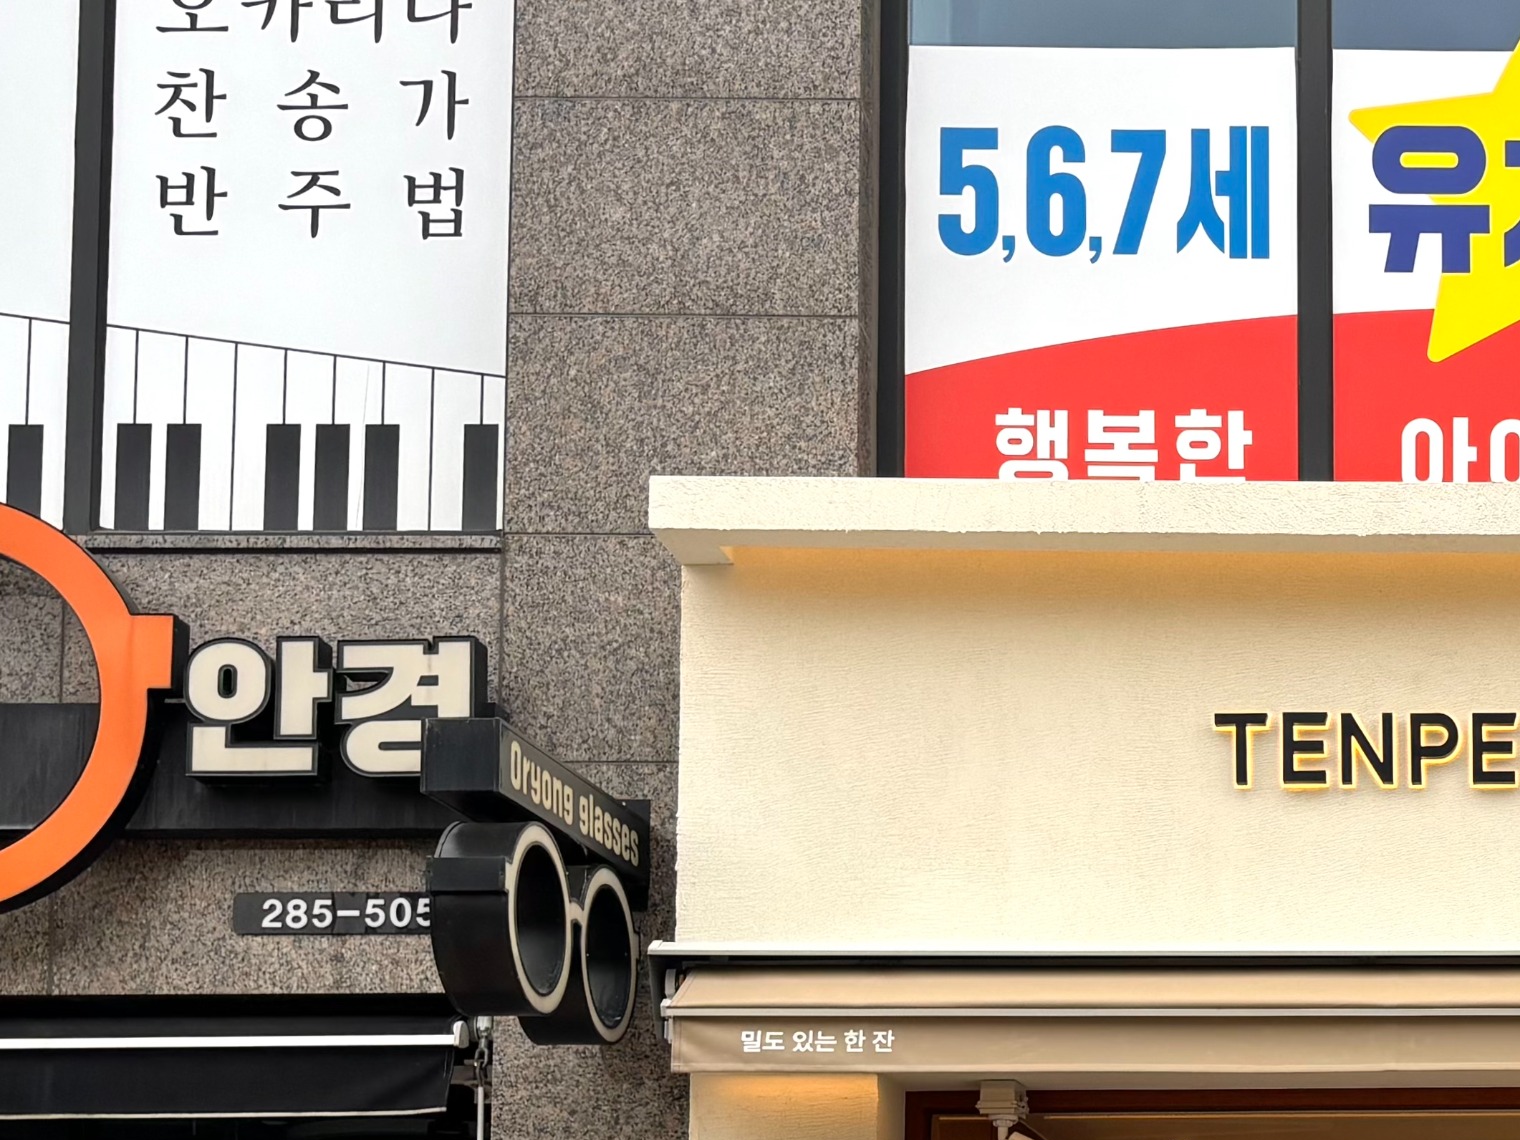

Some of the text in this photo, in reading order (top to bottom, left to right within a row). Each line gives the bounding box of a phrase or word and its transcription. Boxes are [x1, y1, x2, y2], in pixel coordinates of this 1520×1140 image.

[938, 125, 1270, 263] 5,6,7세
[996, 409, 1252, 482] 행복한
[187, 637, 472, 775] 안경
[510, 739, 639, 867] Oryong glasses
[740, 1030, 895, 1053] 밀도 있는 한 잔
